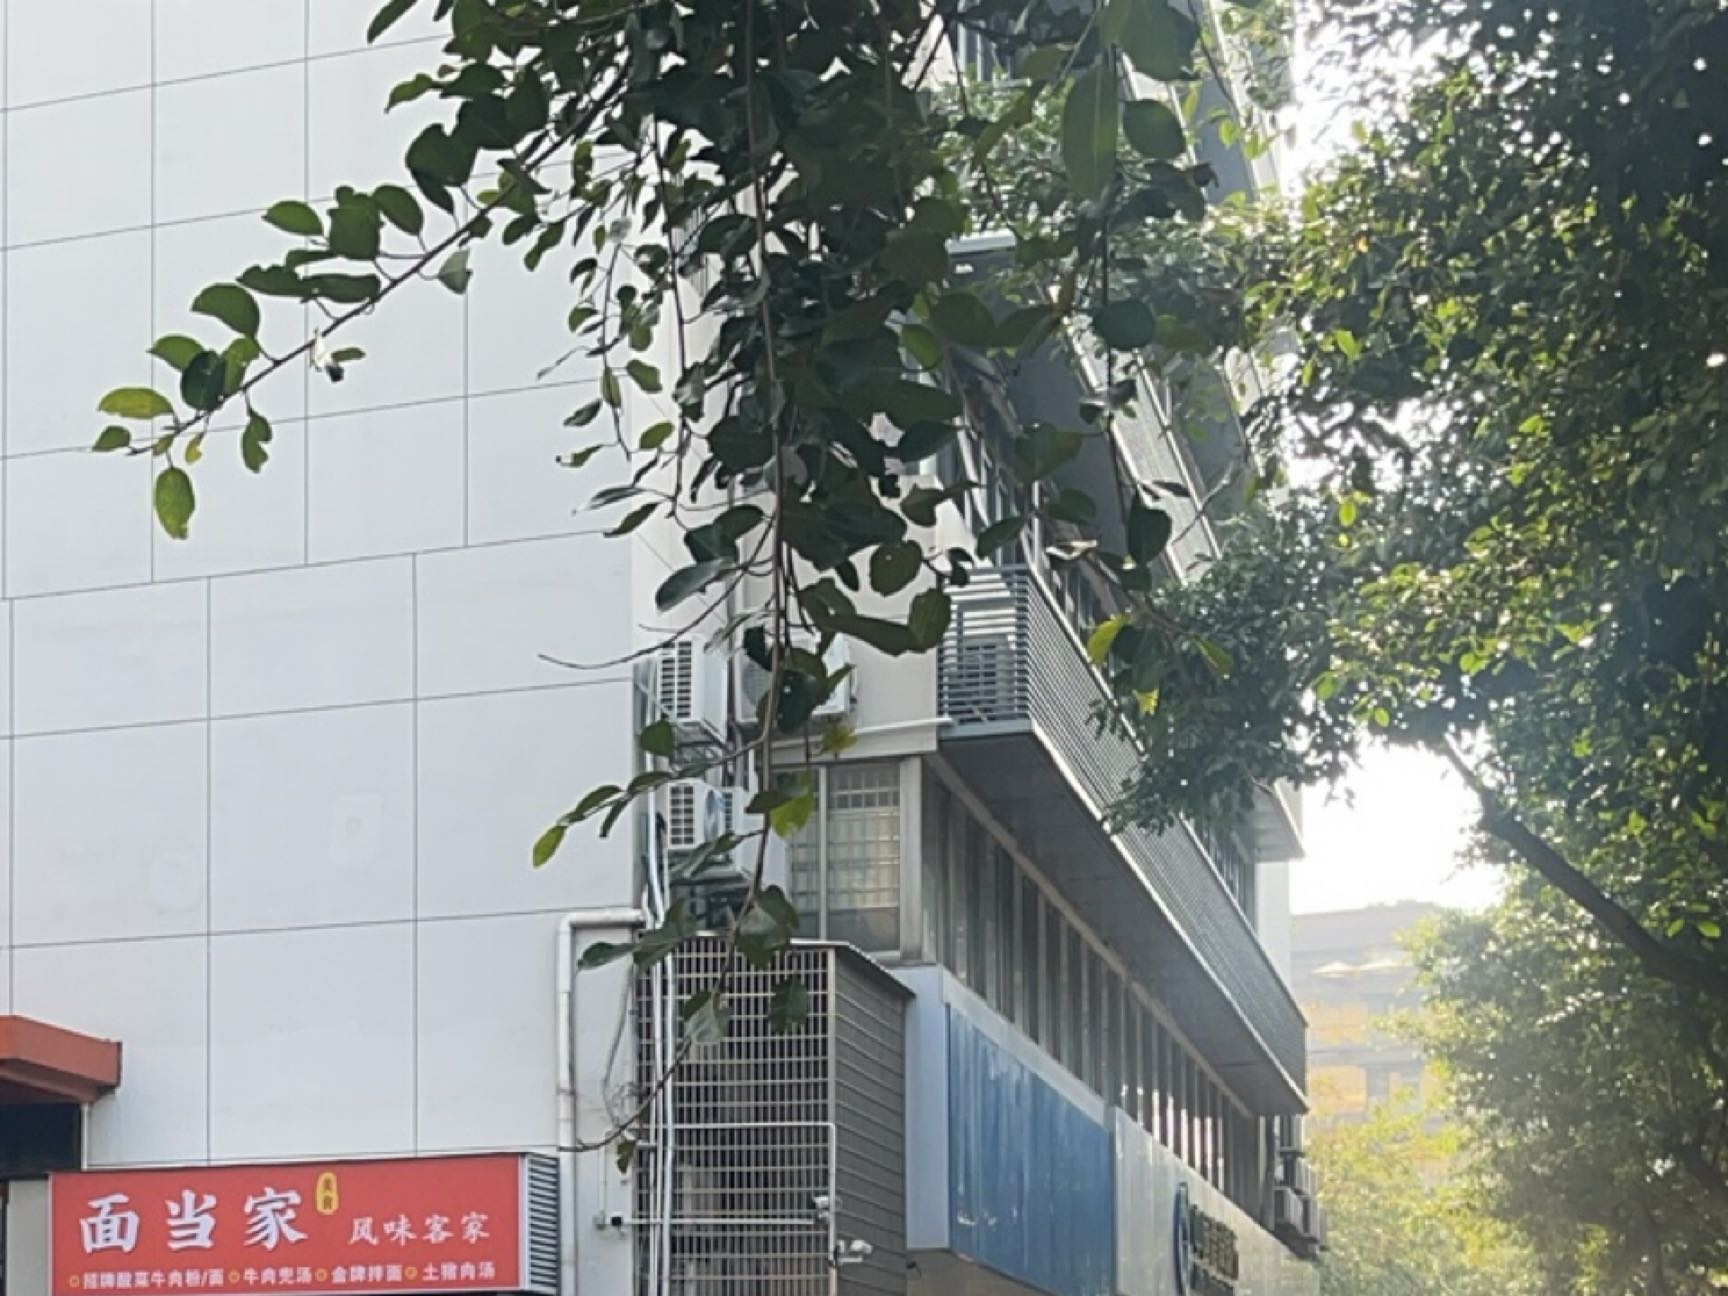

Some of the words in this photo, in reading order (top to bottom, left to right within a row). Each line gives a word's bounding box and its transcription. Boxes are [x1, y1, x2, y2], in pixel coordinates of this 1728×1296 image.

[79, 1186, 309, 1254] 面当家
[348, 1211, 491, 1247] 风味客家
